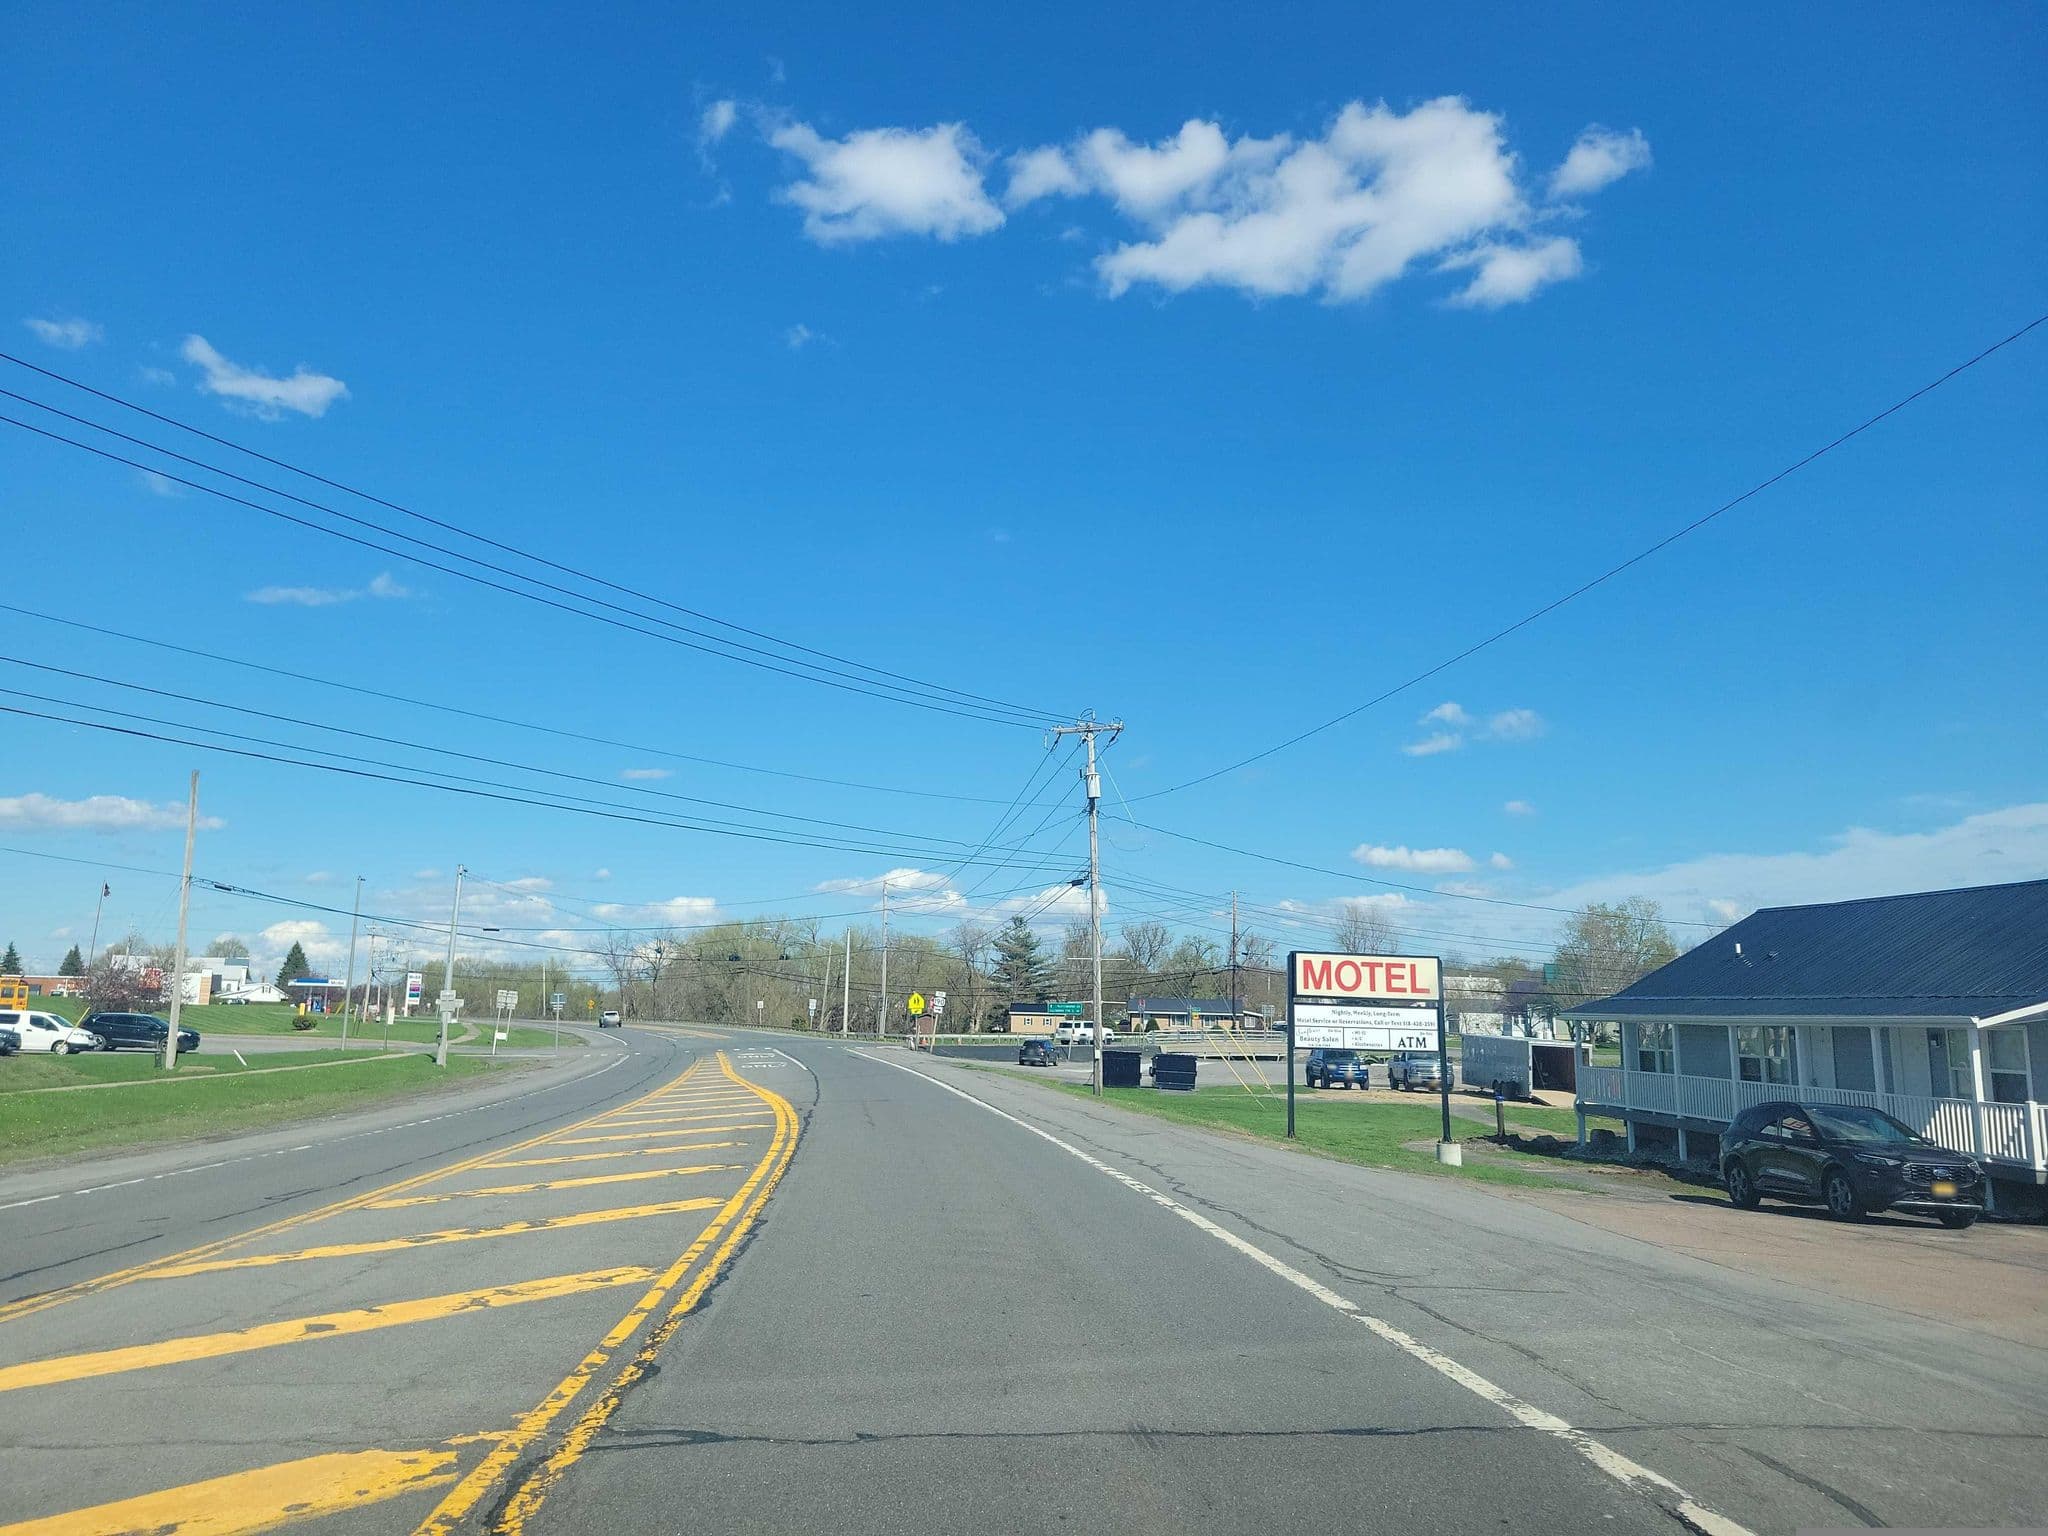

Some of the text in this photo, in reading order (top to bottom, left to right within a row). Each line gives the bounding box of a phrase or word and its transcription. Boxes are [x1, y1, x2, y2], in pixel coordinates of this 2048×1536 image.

[1303, 959, 1430, 994] MOTEL
[934, 998, 945, 1006] 190
[1299, 1035, 1321, 1043] Beauty
[1398, 1036, 1427, 1048] ATM
